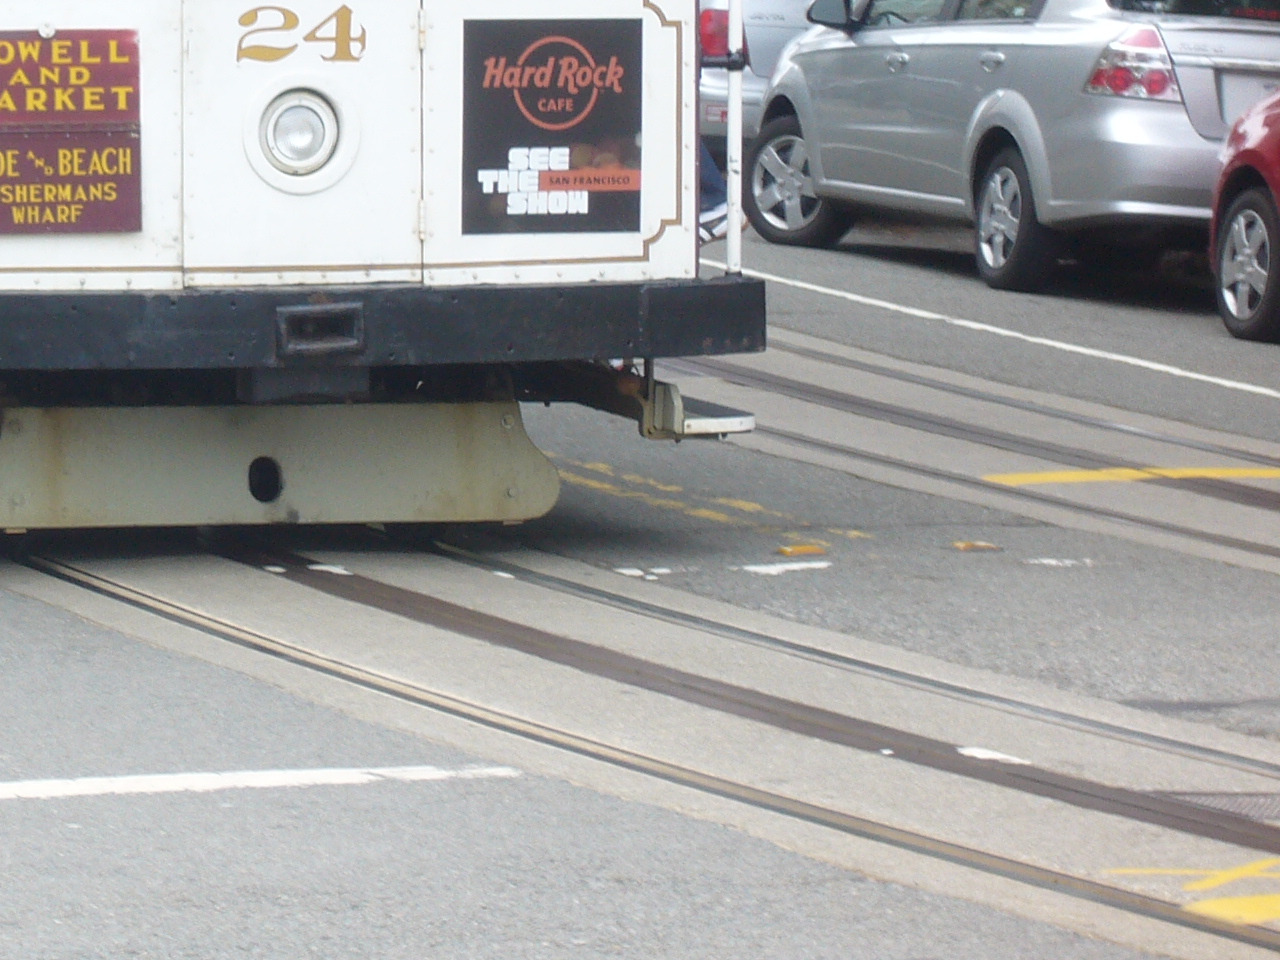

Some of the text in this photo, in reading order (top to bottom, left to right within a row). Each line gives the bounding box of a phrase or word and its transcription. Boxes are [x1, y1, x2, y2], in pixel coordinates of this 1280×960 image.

[236, 4, 366, 63] 24
[9, 66, 92, 86] AND
[482, 55, 625, 94] Hard Rock
[537, 97, 574, 112] CAFE
[58, 147, 132, 176] BEACH
[508, 146, 570, 171] SEE
[477, 169, 540, 194] THE
[549, 176, 631, 186] SAN FRANCISCO
[11, 204, 84, 225] WHARF
[507, 190, 589, 215] SHOW
